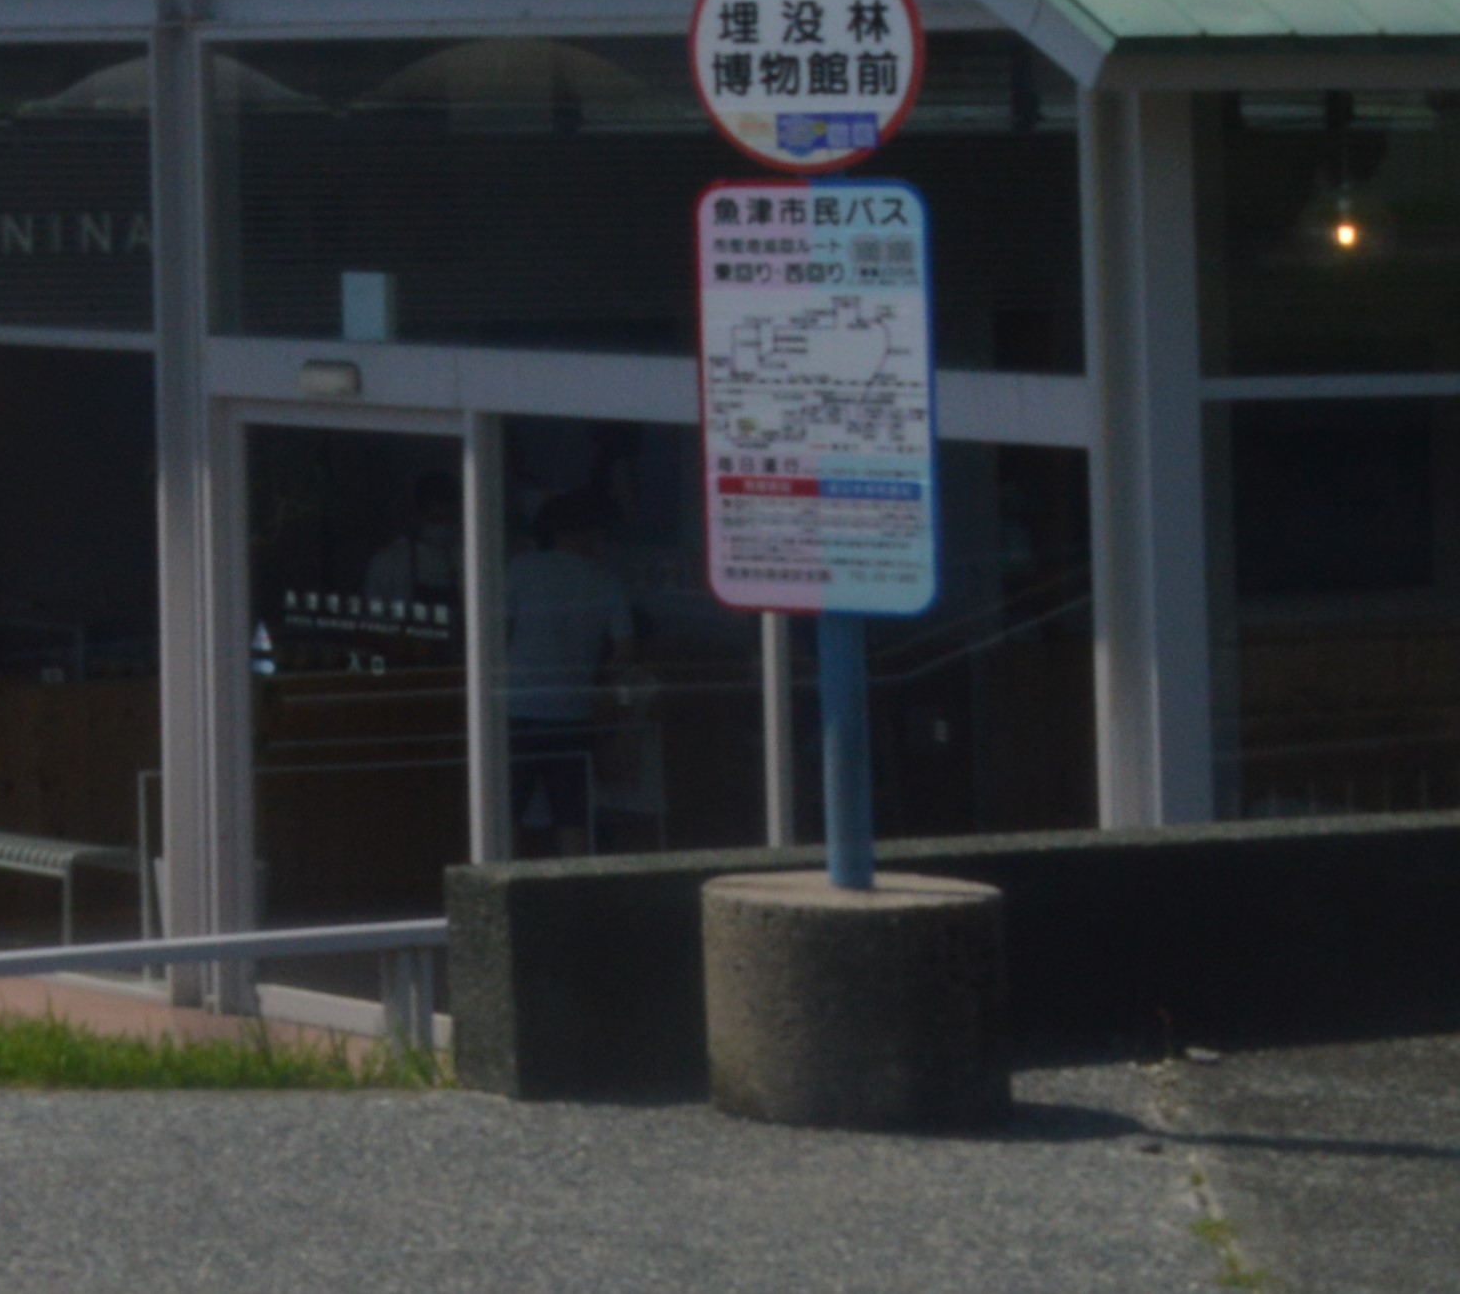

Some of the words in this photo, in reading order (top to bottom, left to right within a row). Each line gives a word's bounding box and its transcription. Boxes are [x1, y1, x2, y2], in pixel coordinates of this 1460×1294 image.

[718, 0, 891, 43] 埋没林
[713, 52, 898, 96] 博物館前
[714, 197, 908, 226] 魚津市民バス
